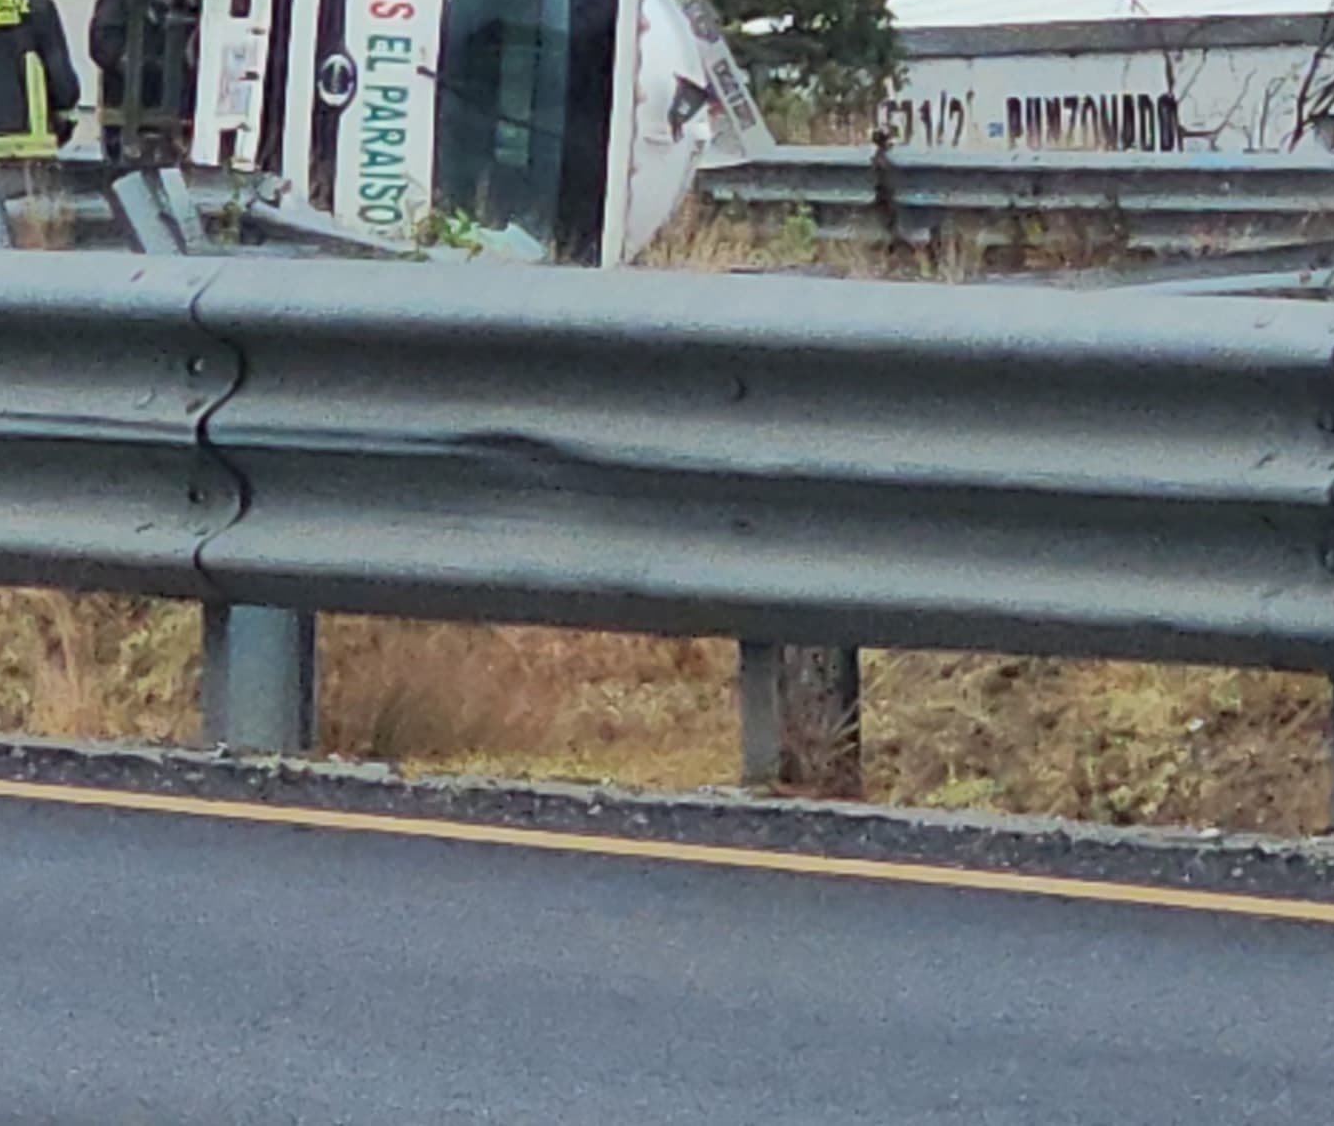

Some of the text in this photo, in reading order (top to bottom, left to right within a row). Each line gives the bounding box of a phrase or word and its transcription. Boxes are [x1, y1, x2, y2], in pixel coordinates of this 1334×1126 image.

[364, 33, 413, 73] EL
[1006, 93, 1179, 152] PUNZONADO
[356, 84, 410, 226] PARAISO
